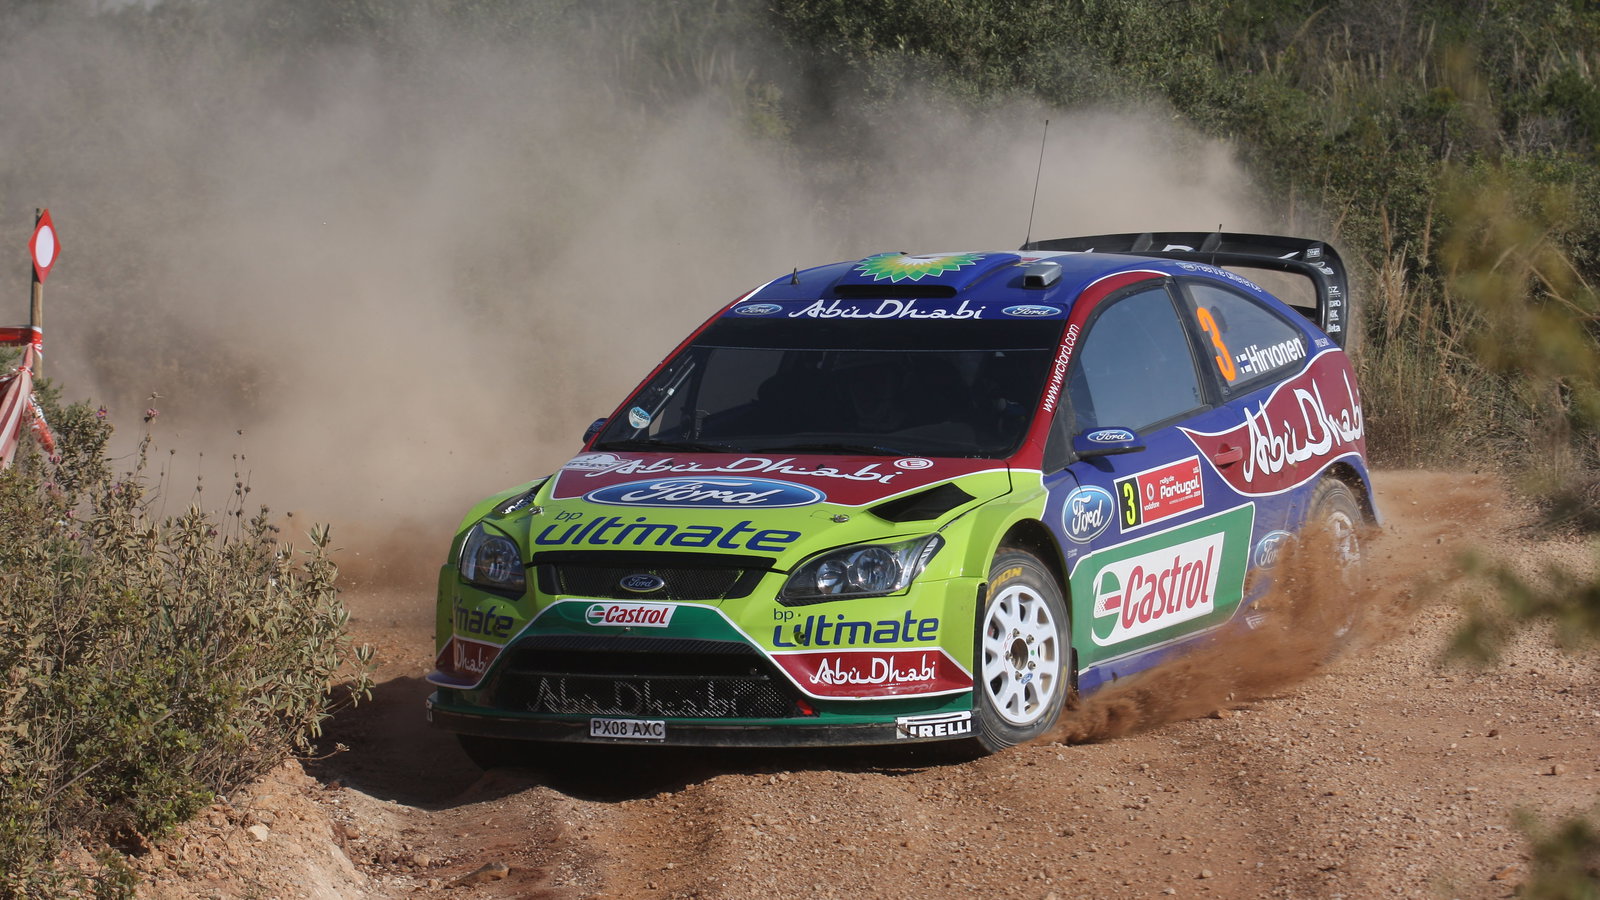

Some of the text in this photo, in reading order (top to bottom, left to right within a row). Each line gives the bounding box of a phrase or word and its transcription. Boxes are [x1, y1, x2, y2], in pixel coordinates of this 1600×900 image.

[1012, 306, 1050, 315] Ford
[1196, 307, 1236, 381] 3
[1245, 337, 1306, 373] Hirvonen
[1043, 323, 1080, 412] www.wrcford.com
[1097, 431, 1126, 441] Ford
[621, 480, 783, 504] Ford
[1160, 475, 1200, 499] Portugal
[1072, 495, 1104, 535] Ford
[1123, 482, 1137, 525] 3
[555, 511, 583, 524] bp
[534, 517, 802, 552] ultimate
[628, 576, 653, 588] Ford
[1122, 545, 1215, 629] Castrol
[604, 605, 670, 625] Castrol
[773, 608, 794, 622] bp
[773, 610, 939, 647] ultimate
[593, 720, 663, 738] PX08 AXC
[897, 711, 972, 739] PIRELLI
